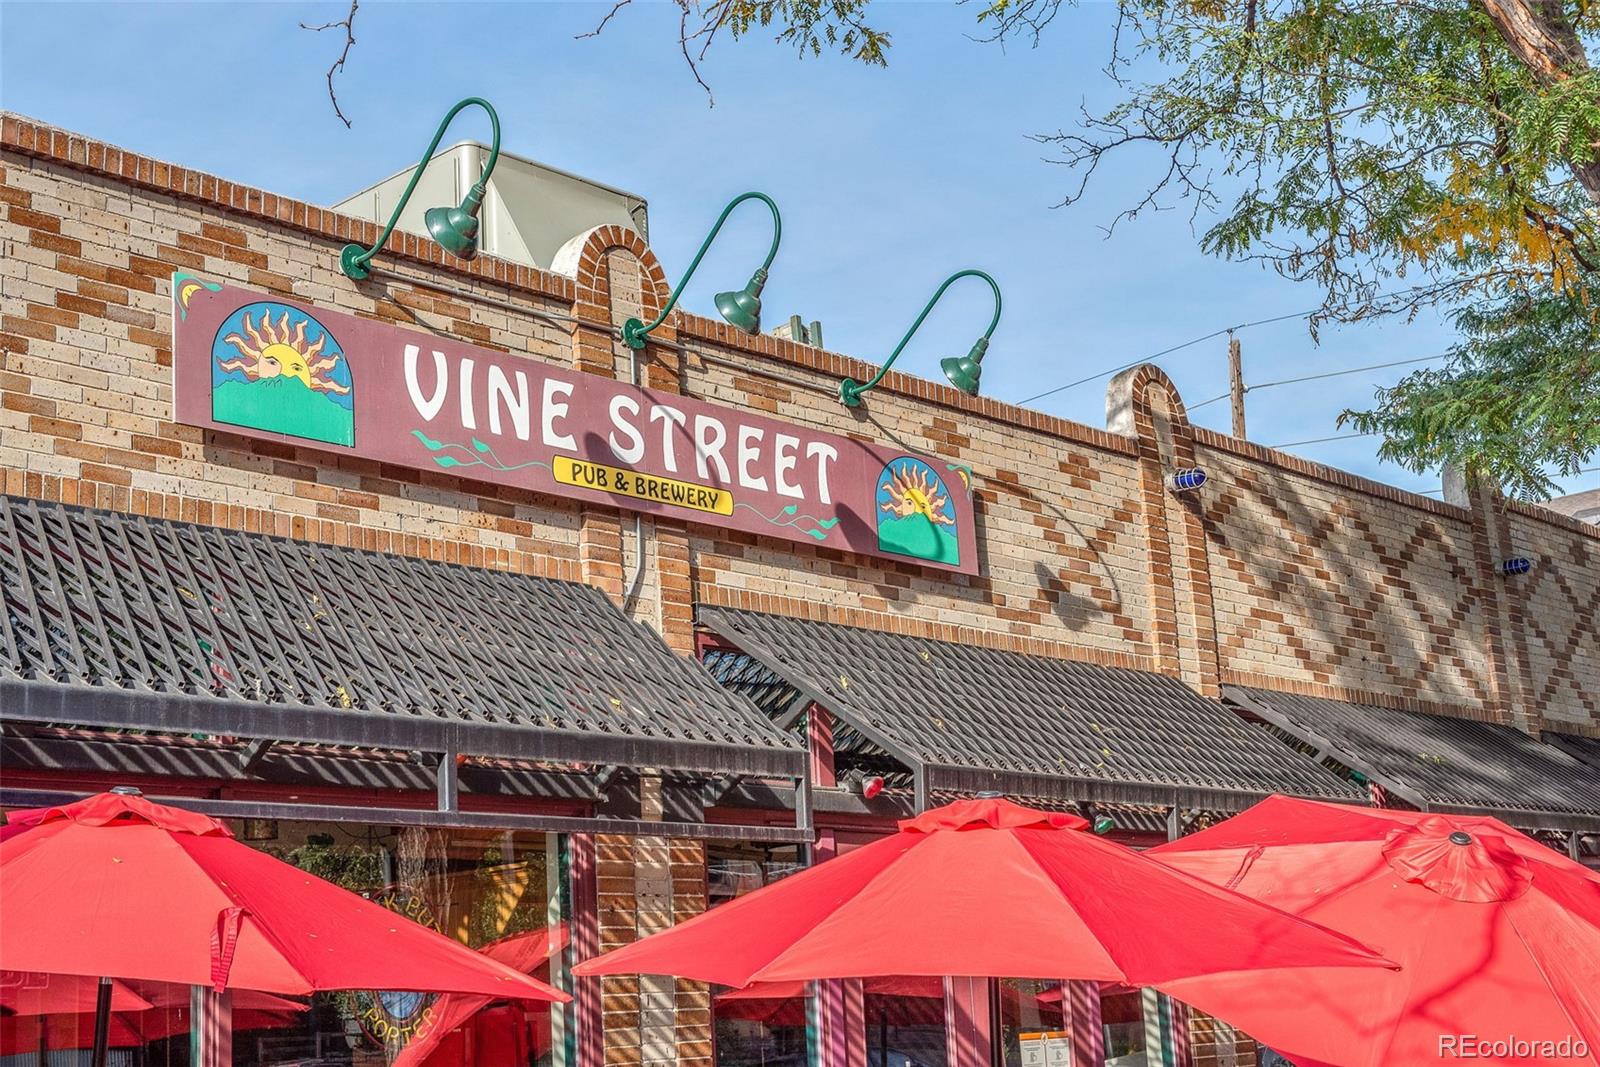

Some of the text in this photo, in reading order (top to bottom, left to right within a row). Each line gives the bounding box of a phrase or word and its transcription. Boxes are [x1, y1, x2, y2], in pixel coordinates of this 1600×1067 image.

[403, 344, 838, 505] VINE STREET
[571, 462, 719, 510] PUB & BREWERY
[363, 1007, 437, 1046] PORTER
